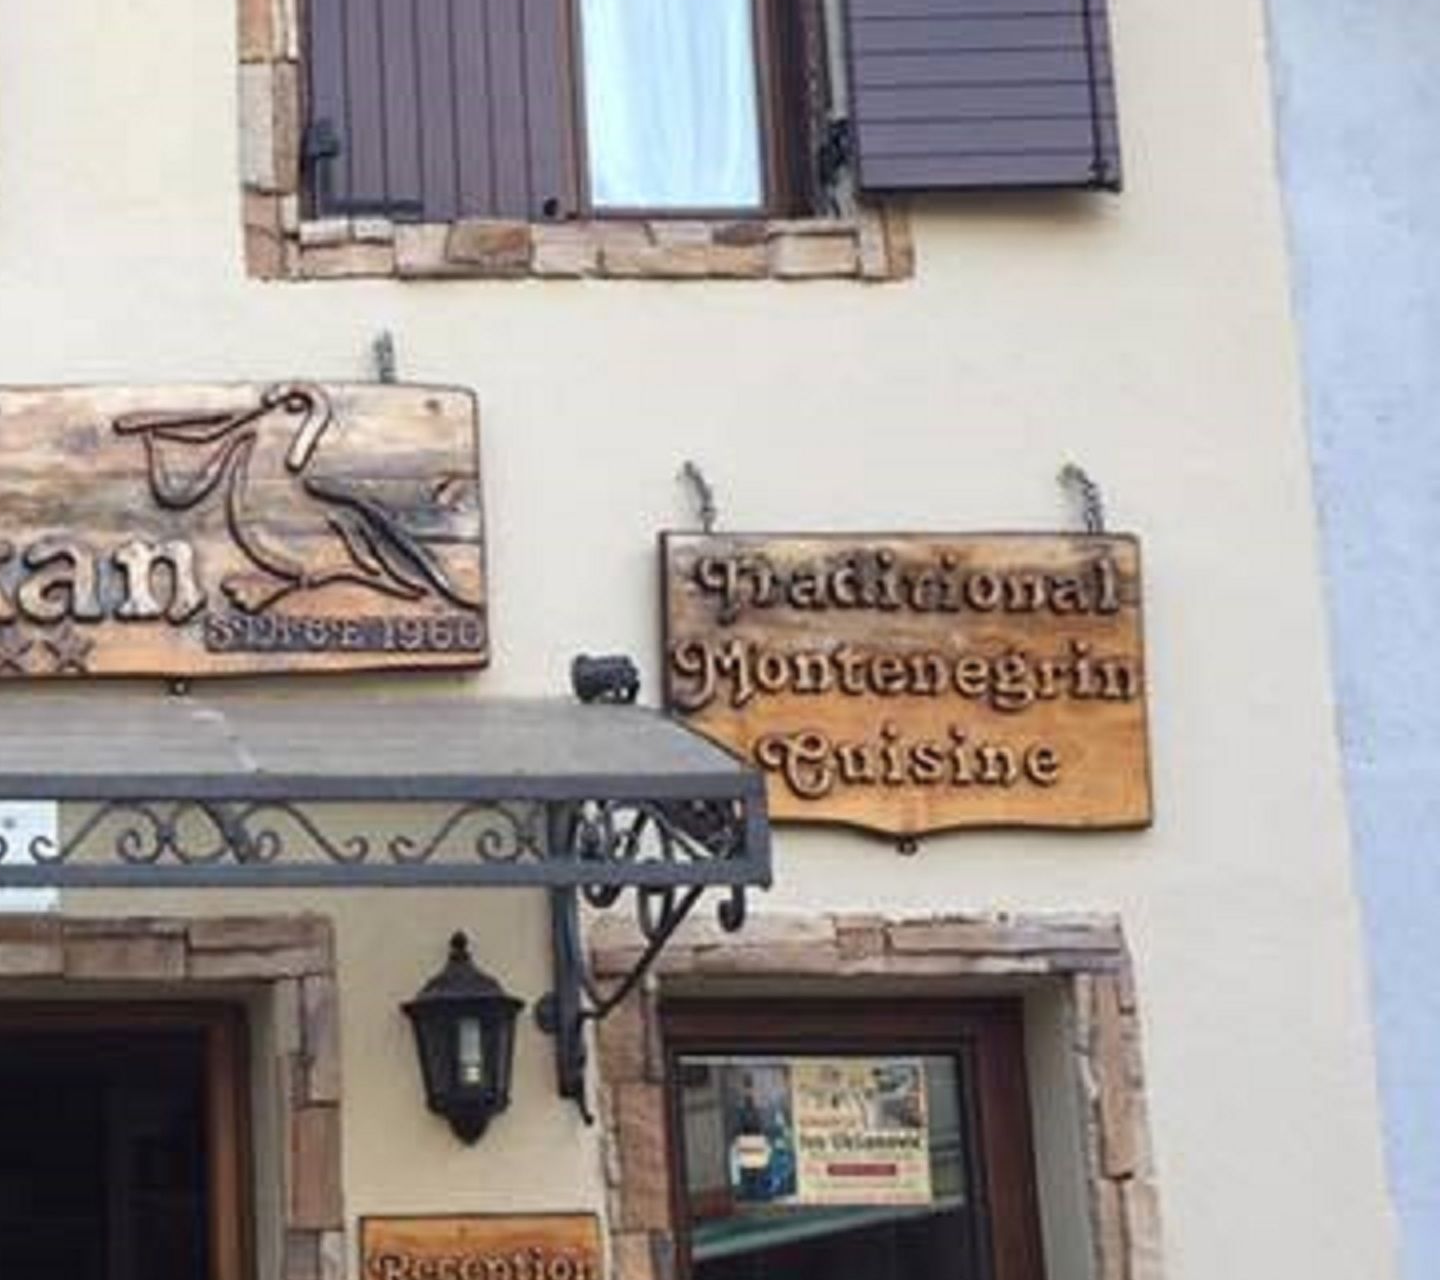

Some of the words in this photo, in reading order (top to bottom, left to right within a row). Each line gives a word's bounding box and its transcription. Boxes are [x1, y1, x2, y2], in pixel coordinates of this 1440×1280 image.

[696, 548, 1123, 626] Traditional
[673, 639, 1140, 712] Montenegrin
[755, 726, 1062, 800] Cuisine
